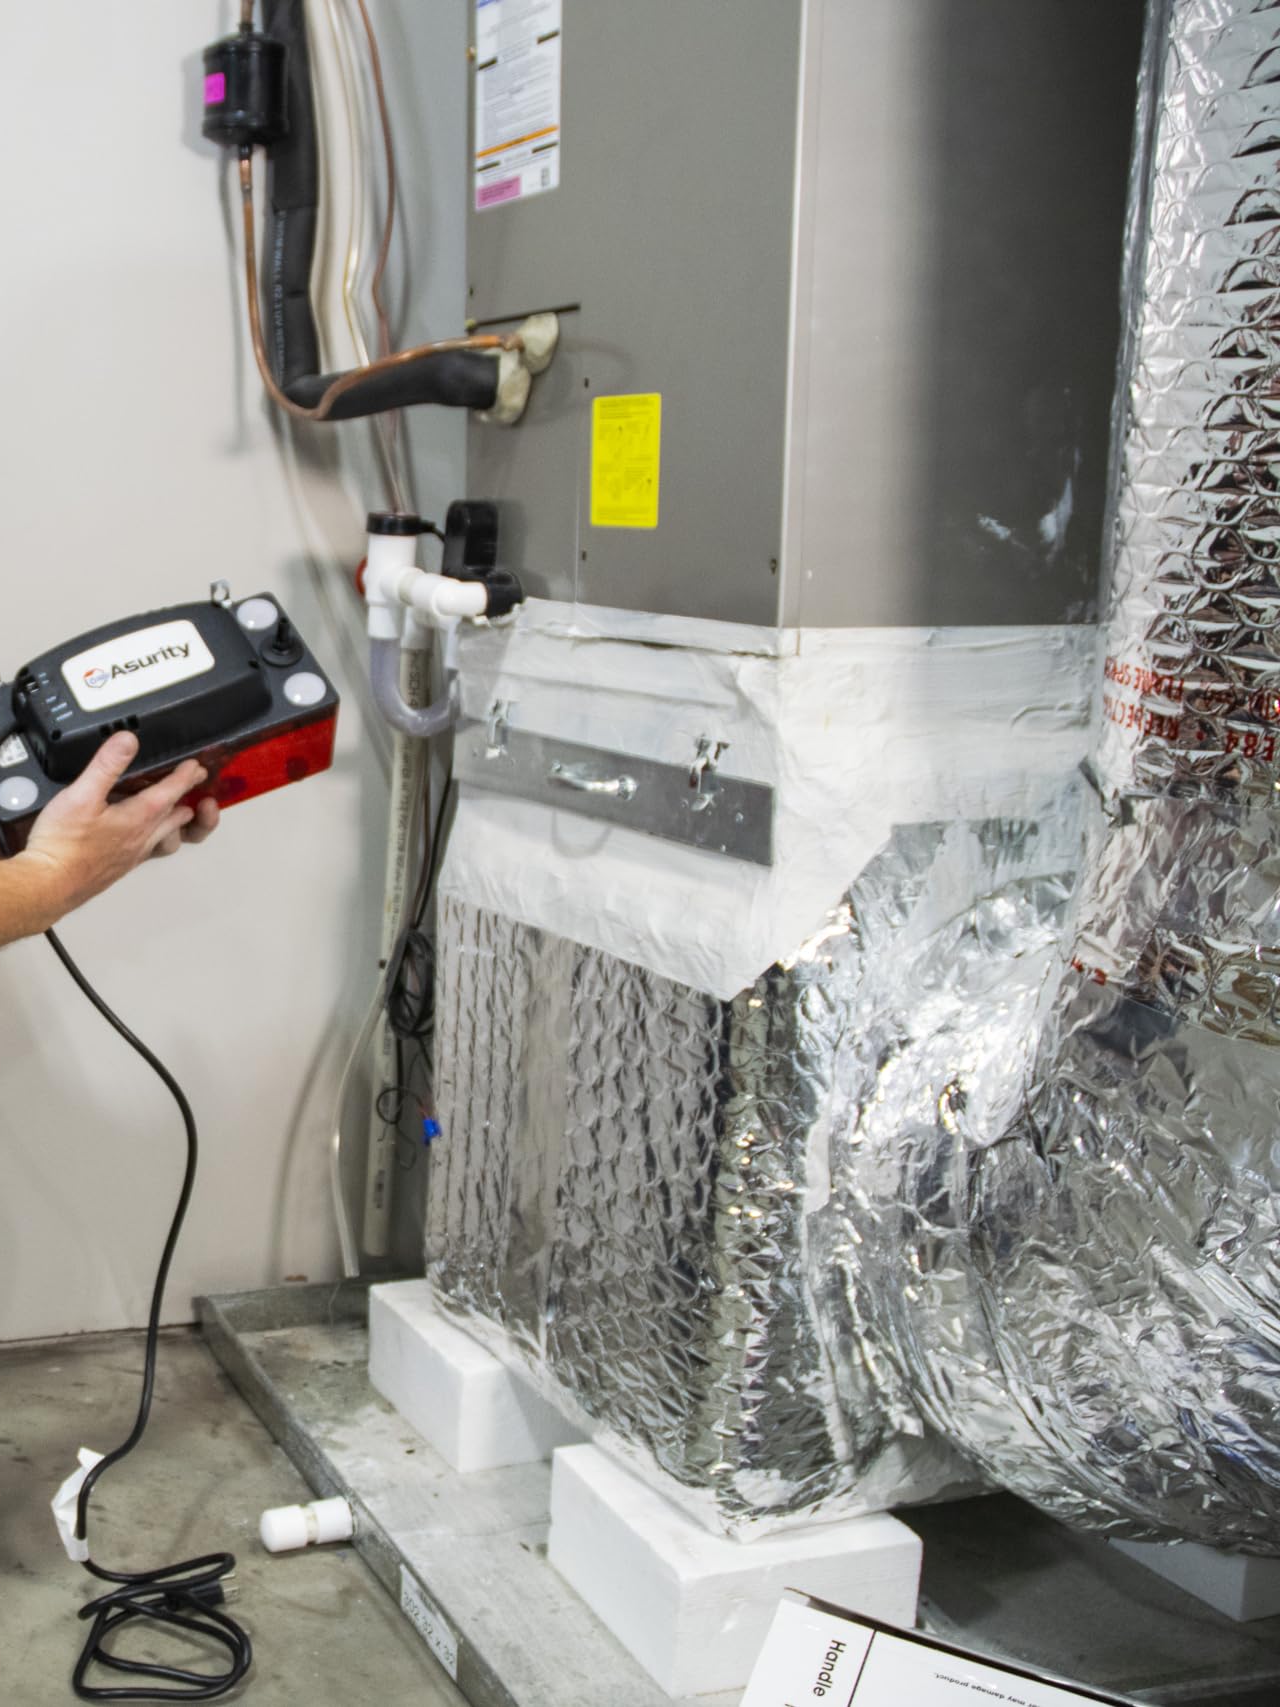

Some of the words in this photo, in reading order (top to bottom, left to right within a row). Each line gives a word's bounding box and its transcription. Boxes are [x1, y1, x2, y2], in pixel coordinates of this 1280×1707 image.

[111, 643, 190, 679] Asurity
[1225, 729, 1276, 762] E84
[813, 1639, 847, 1697] Handle
[934, 1671, 969, 1688] product.
[971, 1684, 1005, 1699] damage
[1007, 1696, 1026, 1706] may
